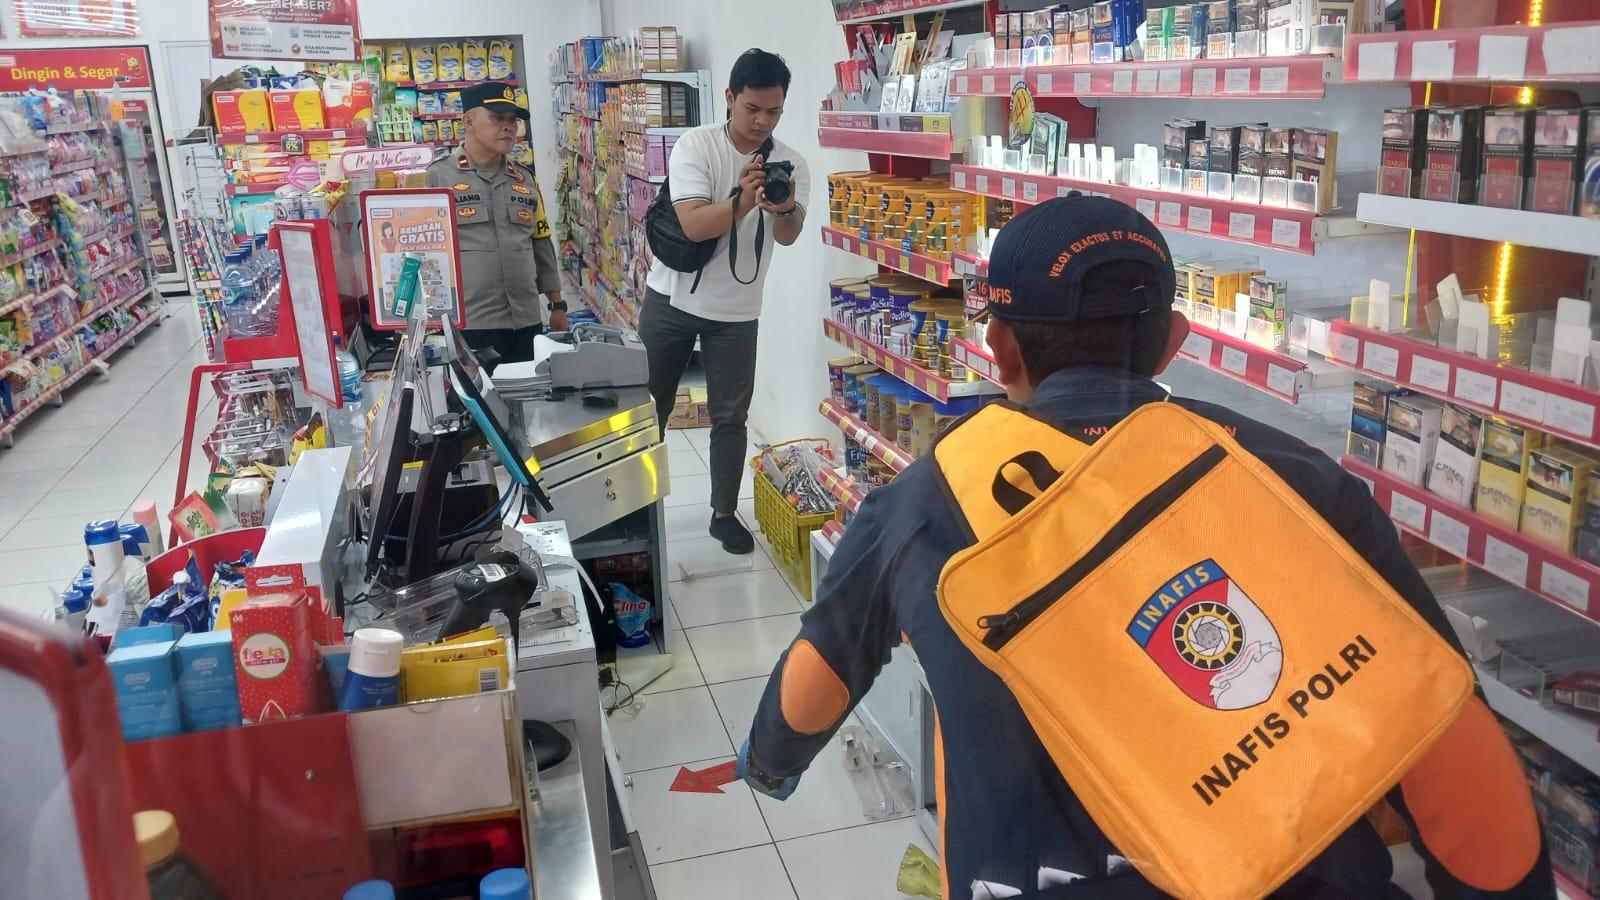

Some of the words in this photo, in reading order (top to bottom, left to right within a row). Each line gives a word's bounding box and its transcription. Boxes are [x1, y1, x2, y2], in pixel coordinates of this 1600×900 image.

[11, 67, 60, 82] Dingin
[63, 66, 76, 79] &
[79, 66, 119, 80] Segar
[381, 151, 393, 168] Up
[399, 231, 445, 244] GRATIS
[400, 222, 441, 235] BENERAN
[1049, 251, 1072, 277] VELOX
[1070, 232, 1110, 253] EXACTUS
[1112, 231, 1123, 240] ET
[1435, 462, 1465, 486] CAMEL
[1480, 486, 1514, 505] CAMEL
[1528, 506, 1568, 530] CAMEL
[1136, 565, 1211, 631] INAFIS
[1191, 712, 1290, 806] INAFIS
[1286, 634, 1377, 719] POLRI
